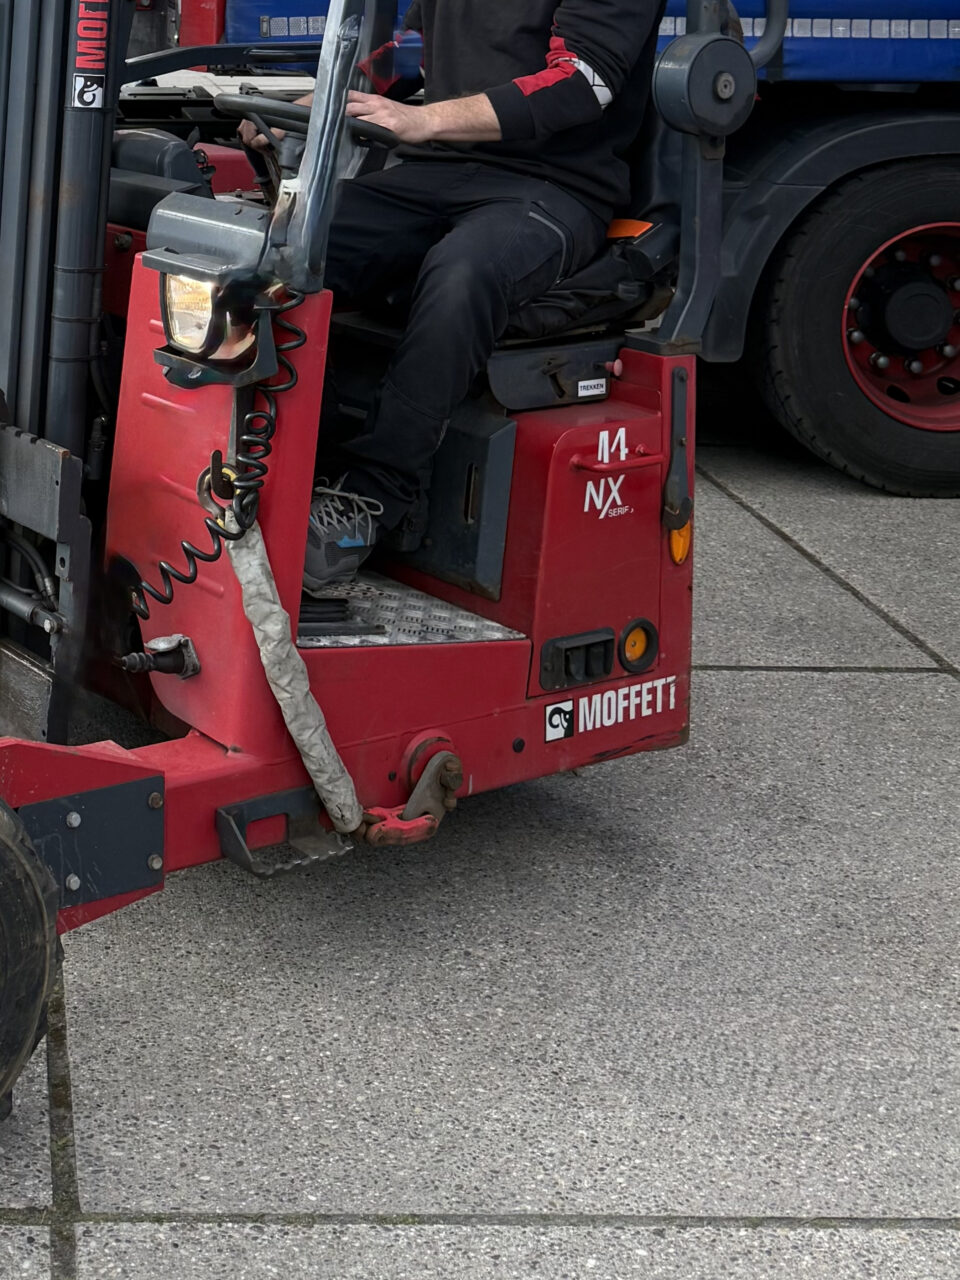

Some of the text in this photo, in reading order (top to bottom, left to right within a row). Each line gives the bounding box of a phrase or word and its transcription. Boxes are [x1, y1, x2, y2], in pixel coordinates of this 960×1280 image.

[579, 383, 604, 391] TREKKEN
[583, 474, 625, 520] NX
[578, 675, 677, 733] MOFFETT
